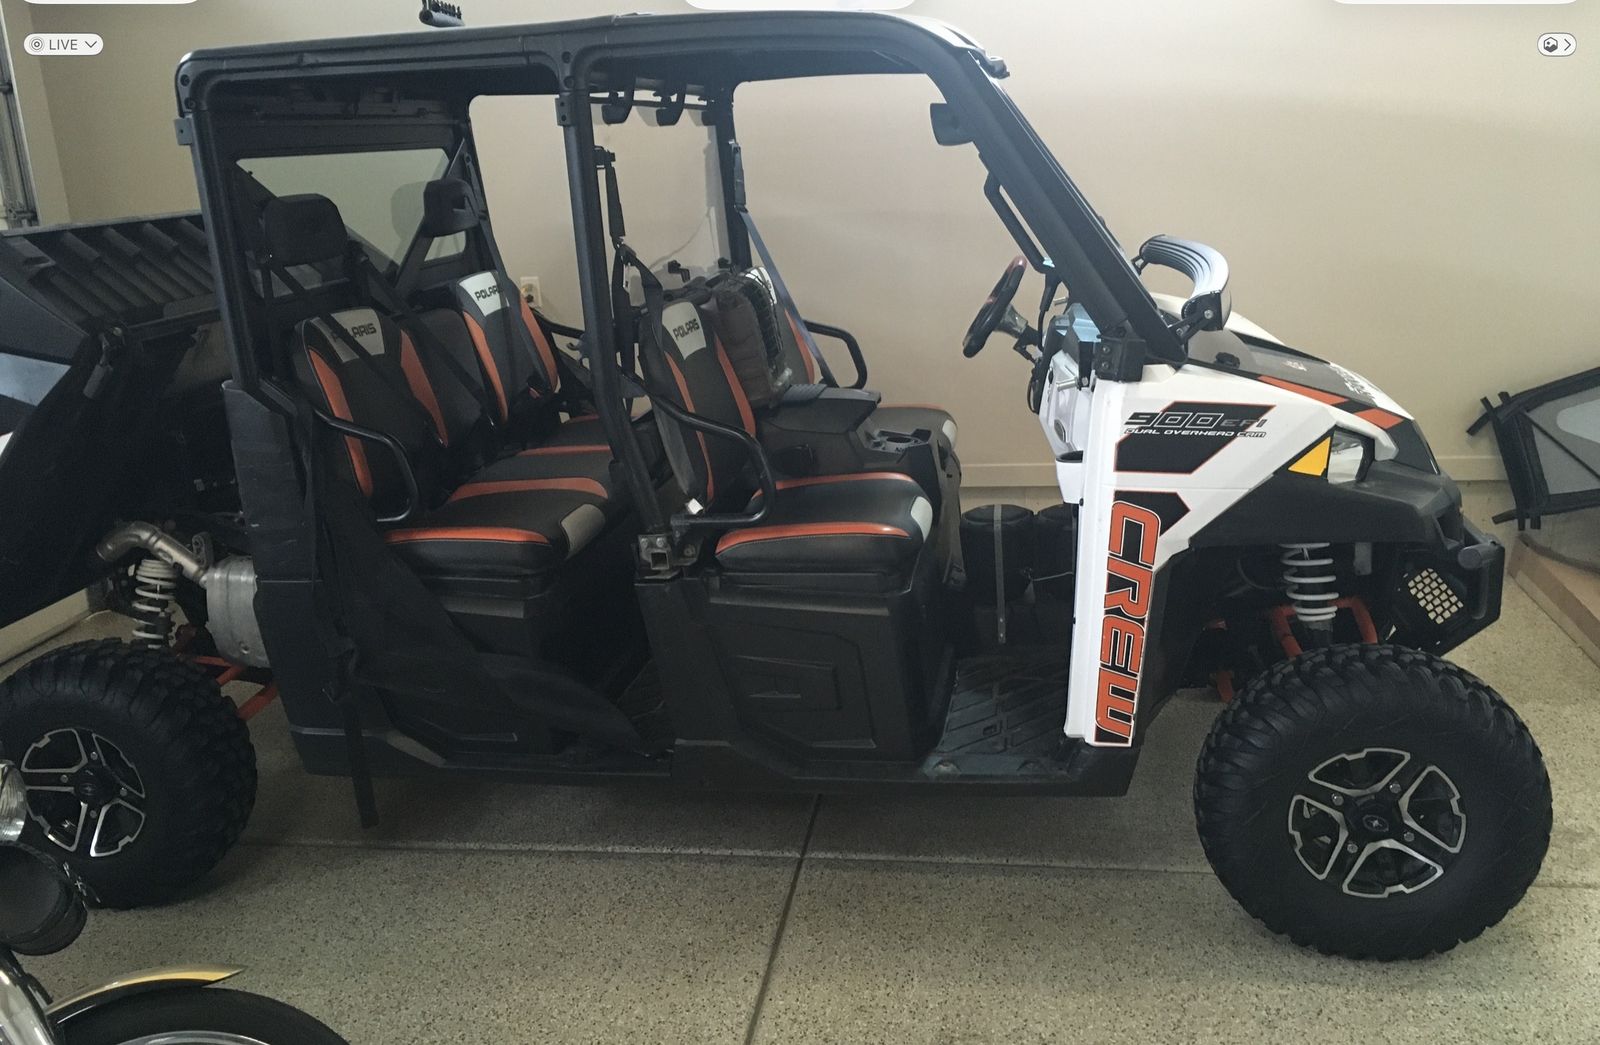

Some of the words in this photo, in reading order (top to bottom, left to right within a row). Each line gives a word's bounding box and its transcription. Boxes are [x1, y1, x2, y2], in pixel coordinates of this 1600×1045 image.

[474, 284, 501, 301] POLAR
[1124, 411, 1224, 429] 900
[1220, 419, 1268, 428] EFI
[1125, 427, 1160, 435] DUAL
[1163, 429, 1235, 437] OVERHEAD
[1095, 500, 1161, 738] CREW
